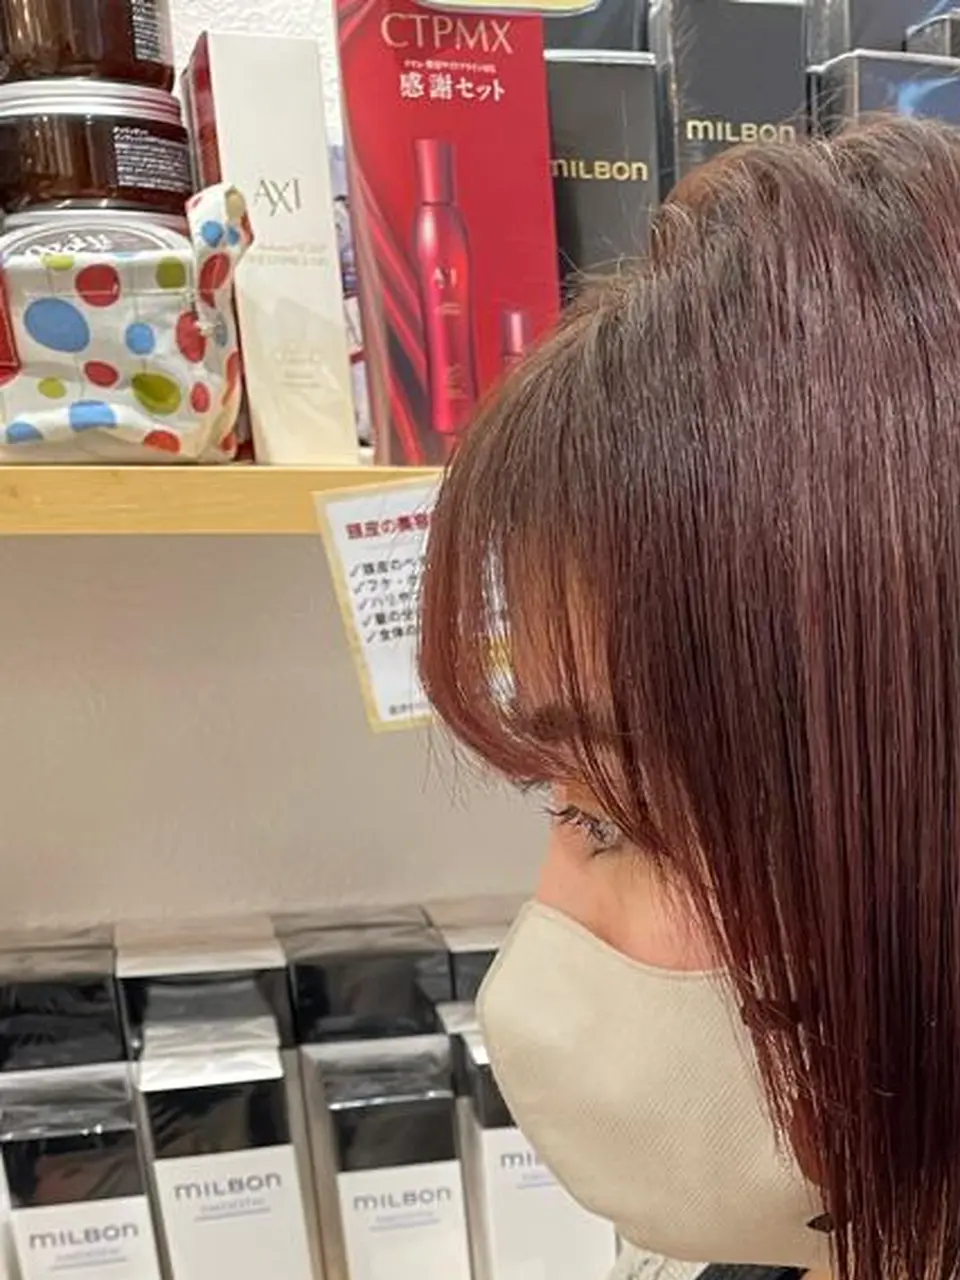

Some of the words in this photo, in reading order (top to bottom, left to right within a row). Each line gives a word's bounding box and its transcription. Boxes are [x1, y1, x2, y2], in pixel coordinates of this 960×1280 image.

[381, 12, 513, 54] CTPMX
[400, 71, 505, 101] 感謝セット
